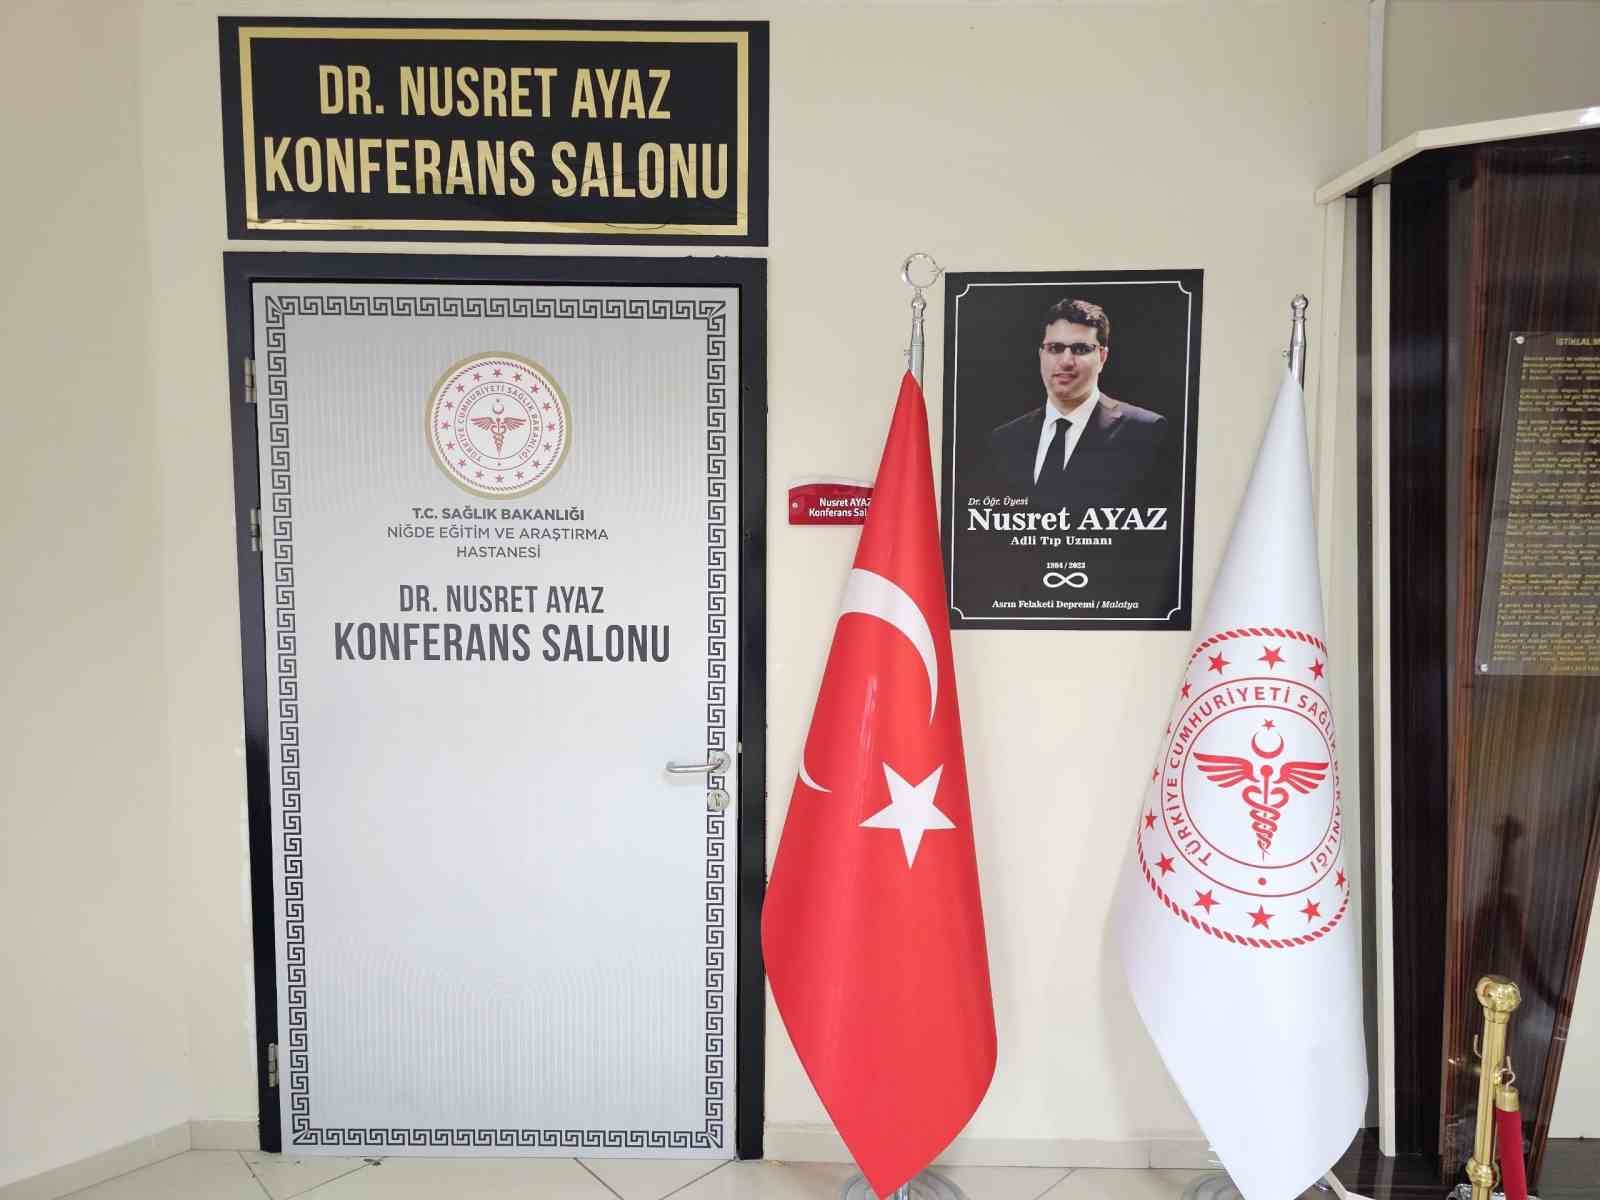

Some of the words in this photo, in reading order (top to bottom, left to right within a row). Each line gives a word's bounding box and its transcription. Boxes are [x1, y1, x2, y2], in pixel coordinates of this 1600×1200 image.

[319, 65, 385, 115] DR.
[400, 66, 558, 118] NUSRET
[571, 68, 671, 120] AYAZ
[264, 136, 536, 197] KONFERANS
[551, 141, 728, 199] SALONU
[819, 497, 848, 507] Nusret
[967, 497, 981, 506] Dr.
[1003, 495, 1029, 507] Üyesi
[411, 507, 438, 520] T.C.
[441, 505, 498, 520] SAĞLIK
[500, 506, 585, 521] BAKANLIĞI
[808, 507, 852, 518] Konferans
[853, 507, 867, 518] Sal
[967, 506, 1071, 531] Nusret
[1076, 507, 1168, 531] AYAZ
[387, 523, 435, 539] NİĞDE
[439, 523, 490, 539] EĞİTİM
[494, 527, 515, 540] VE
[519, 527, 609, 542] ARAŞTIRMA
[1010, 536, 1036, 546] Adli
[1040, 536, 1062, 547] Tıp
[1066, 536, 1112, 546] Uzmanı
[456, 543, 541, 559] HASTANESİ
[399, 584, 438, 613] DR.
[446, 584, 538, 613] NUSRET
[546, 585, 605, 614] AYAZ
[991, 600, 1017, 609] Asrın
[1018, 599, 1054, 609] Felaketi
[1056, 600, 1095, 610] Depremi
[1101, 600, 1139, 610] Malatya
[334, 622, 531, 662] KONFERANS
[542, 623, 671, 663] SALONU
[1170, 686, 1291, 770] CUMHURİYETİ
[1166, 776, 1213, 866] TÜRKİYE
